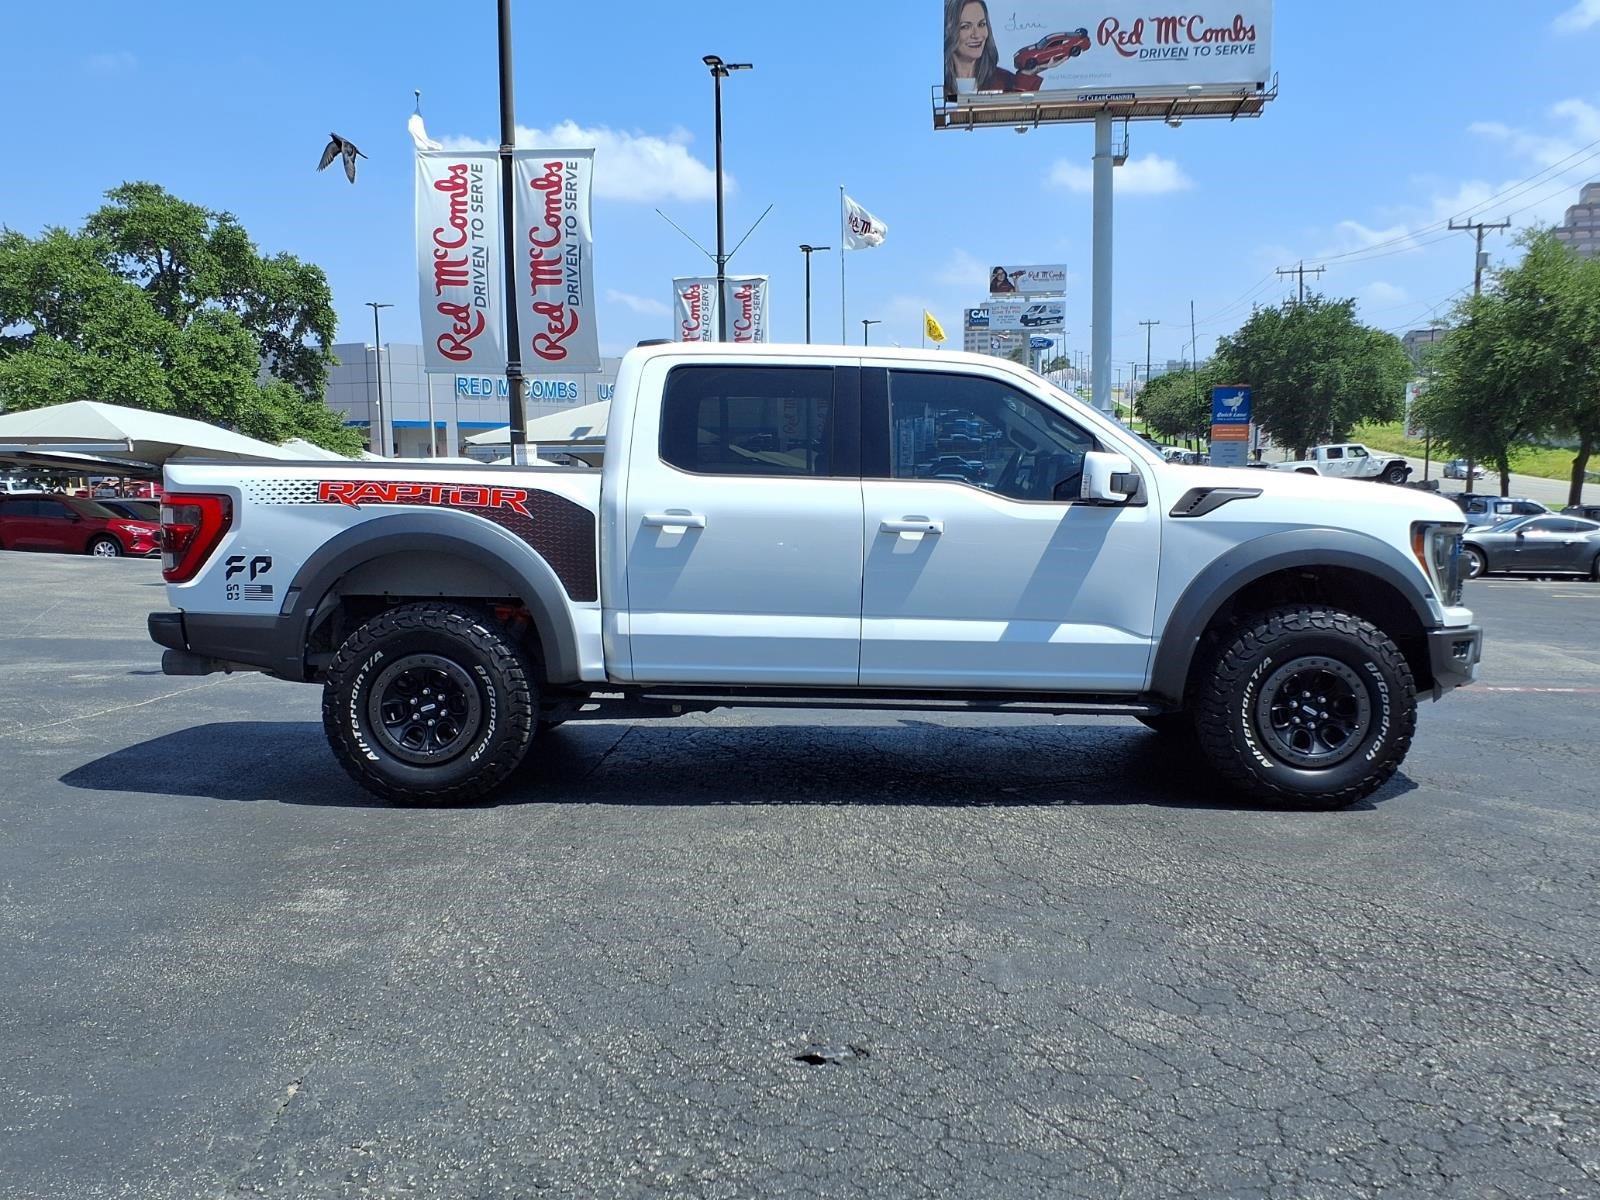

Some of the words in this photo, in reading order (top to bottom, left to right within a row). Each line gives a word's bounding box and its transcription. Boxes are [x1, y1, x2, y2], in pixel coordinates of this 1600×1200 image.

[1096, 17, 1144, 57] Red
[1149, 14, 1256, 44] McCombs
[1139, 47, 1188, 59] DRIVEN
[1194, 46, 1210, 57] TO
[1215, 44, 1256, 56] SERVE
[471, 163, 484, 213] SERVE
[565, 161, 578, 211] SERVE
[432, 162, 470, 297] McCombs
[472, 217, 485, 240] TO
[529, 161, 564, 296] McCombs
[565, 215, 577, 239] TO
[473, 246, 487, 308] DRIVEN
[566, 243, 580, 306] DRIVEN
[702, 283, 710, 312] SERVE
[436, 301, 486, 361] Red
[532, 301, 579, 361] Red
[702, 314, 709, 327] TO
[753, 313, 760, 327] TO
[457, 377, 493, 396] RED
[319, 481, 535, 520] RAPTOR
[225, 556, 272, 581] FP
[362, 650, 384, 673] T/A
[1252, 656, 1272, 680] T/A
[350, 673, 380, 761] All-Terrain
[470, 665, 496, 762] BFGoodrich
[1241, 681, 1274, 768] All-Terrain
[1364, 662, 1390, 761] BFGoodrich
